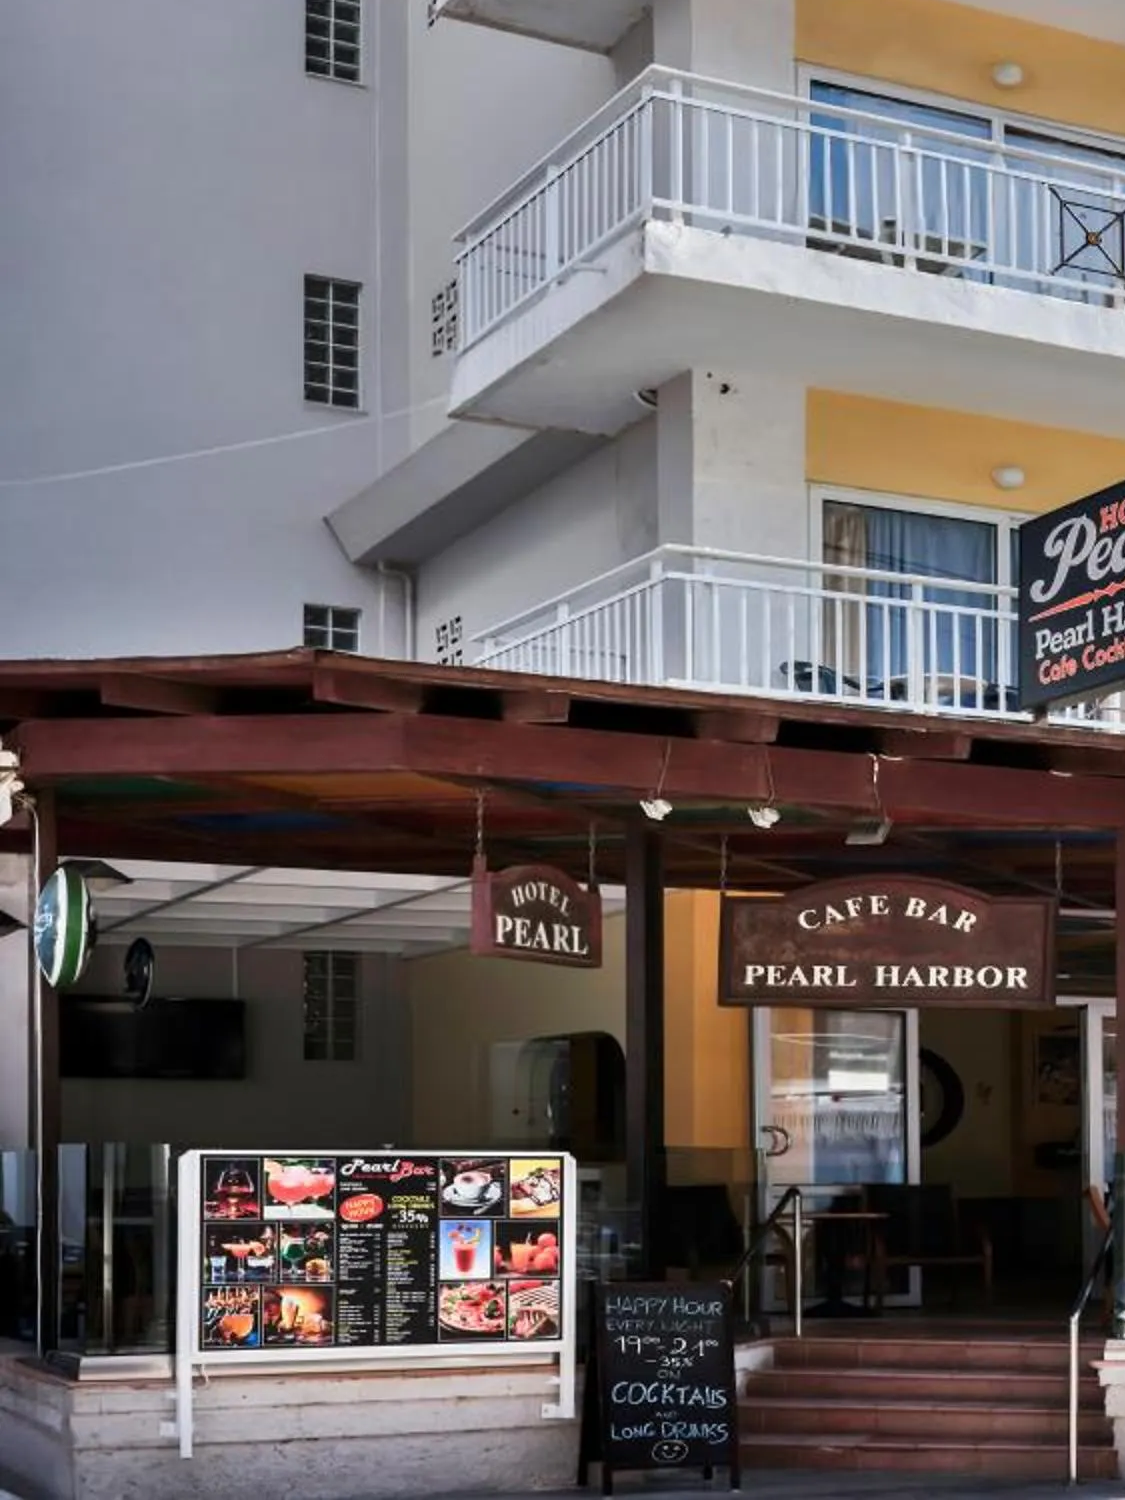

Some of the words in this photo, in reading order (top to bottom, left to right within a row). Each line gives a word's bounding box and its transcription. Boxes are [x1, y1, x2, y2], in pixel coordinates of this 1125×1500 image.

[1035, 609, 1094, 660] Pearl
[1039, 655, 1077, 685] Cafe
[511, 881, 570, 917] HOTEL
[798, 895, 890, 930] CAFE
[905, 897, 978, 933] BAR
[495, 914, 589, 955] PEARL
[744, 965, 857, 987] PEARL
[874, 965, 1028, 989] HARBOR
[340, 1158, 400, 1176] Pearl
[389, 1161, 435, 1183] Bar
[605, 1297, 667, 1316] HAPPY
[673, 1297, 723, 1316] HOUR
[606, 1318, 655, 1332] EVERY
[656, 1369, 681, 1381] ON
[611, 1381, 728, 1409] COCKTAILS
[610, 1422, 656, 1441] LONG
[661, 1422, 729, 1445] DRINKS
